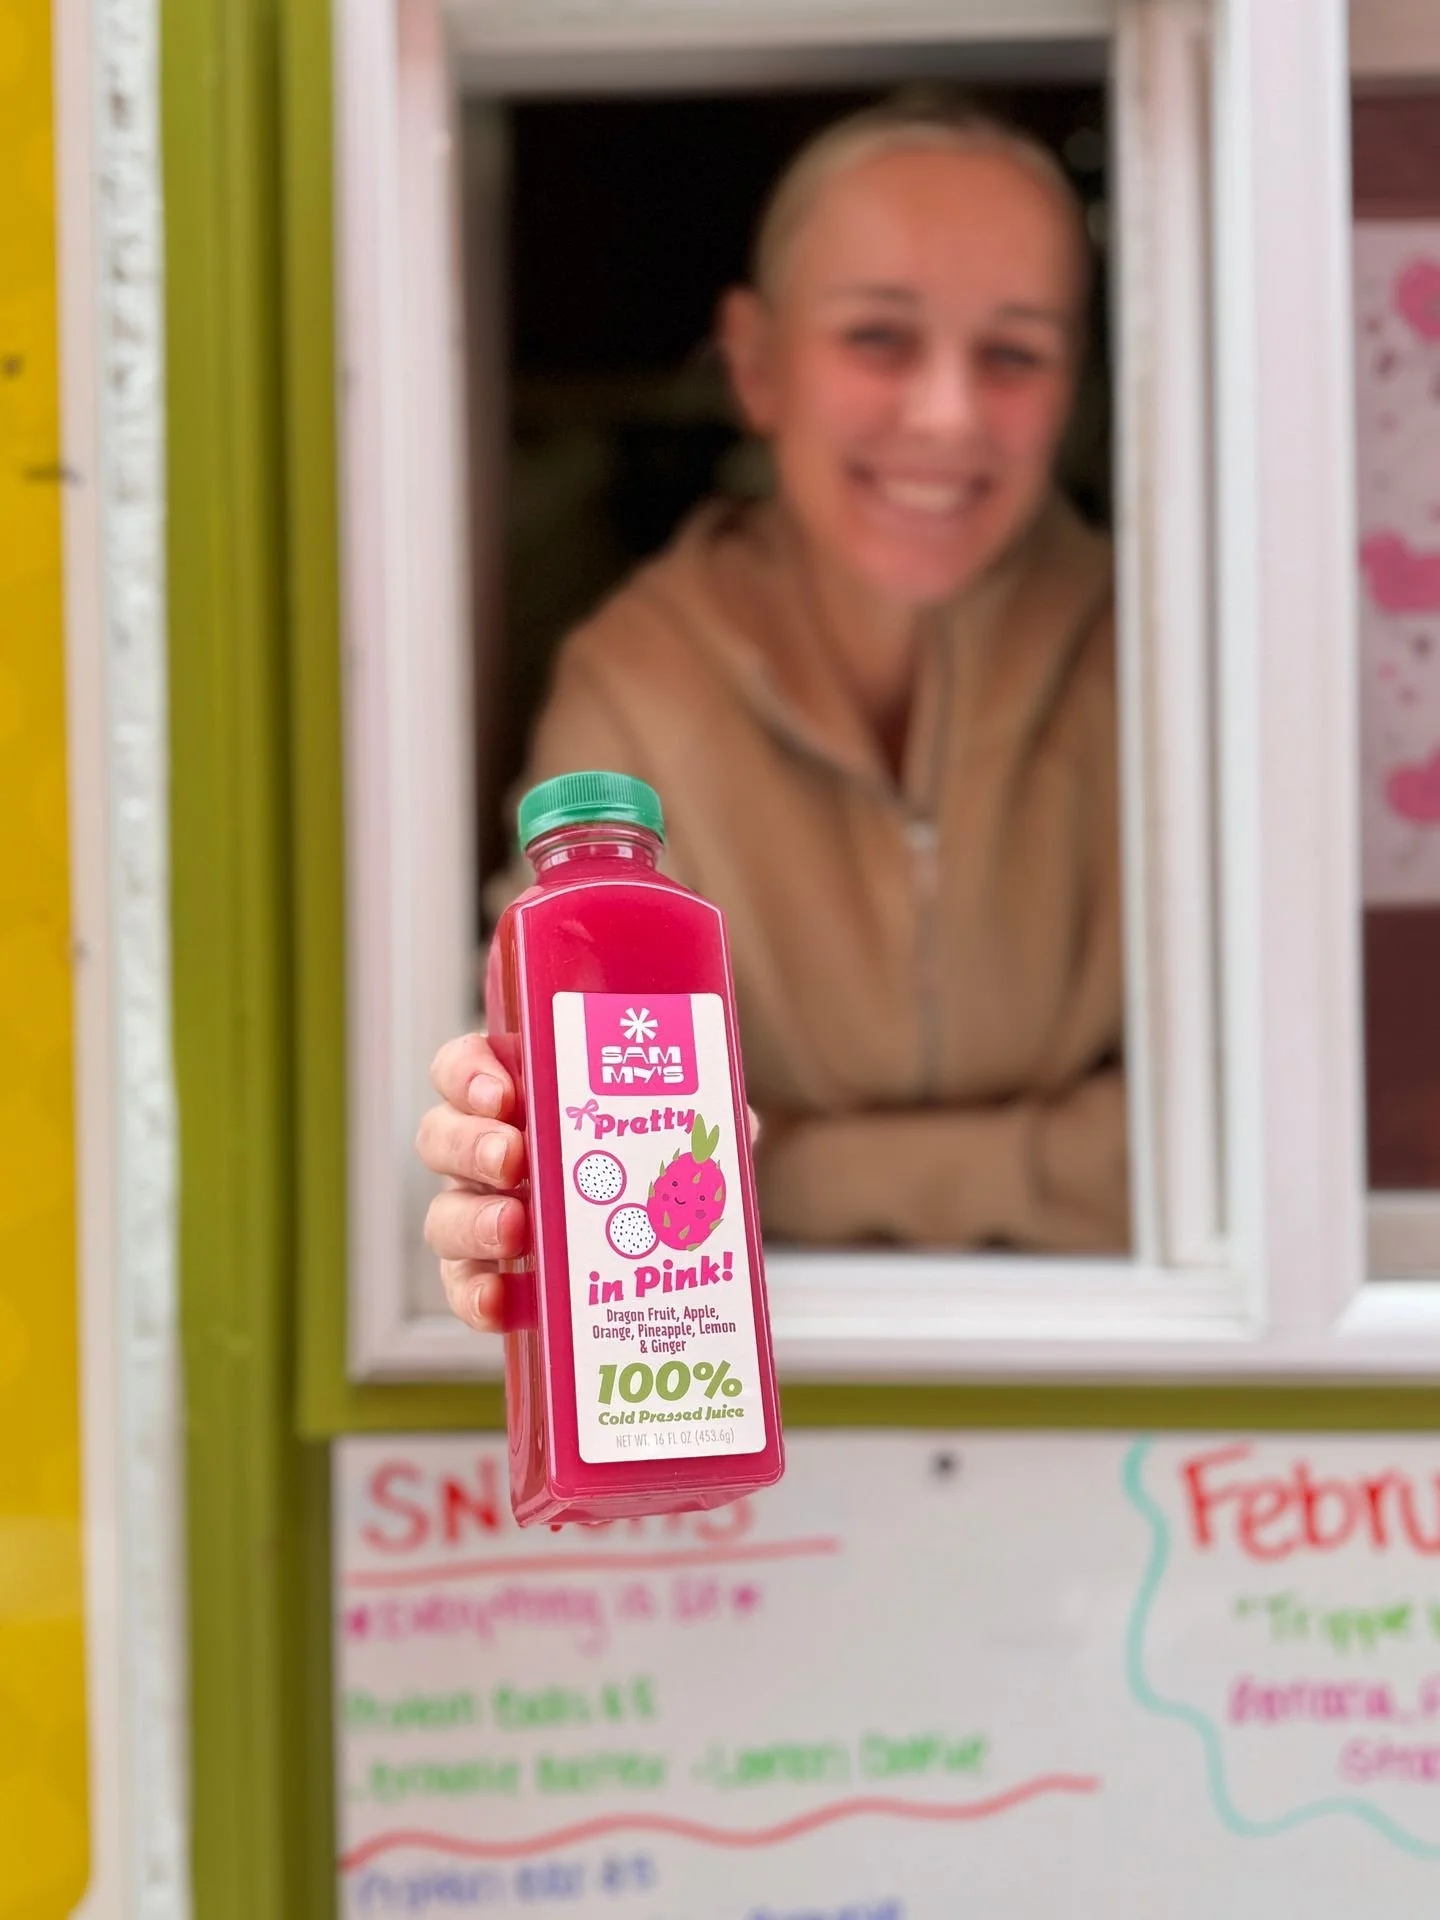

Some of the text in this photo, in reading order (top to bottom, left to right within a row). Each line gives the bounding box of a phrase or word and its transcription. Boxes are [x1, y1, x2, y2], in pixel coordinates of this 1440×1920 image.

[601, 1046, 682, 1064] SAM
[602, 1066, 685, 1084] MY'S
[594, 1107, 695, 1140] Pretty
[588, 1251, 734, 1305] in Pink!
[607, 1305, 719, 1324] Dragon Fruit, Apple,
[592, 1319, 736, 1341] Orange, Pineapple, Lemon
[640, 1339, 687, 1355] & Ginger
[597, 1360, 743, 1405] 100%
[598, 1404, 744, 1426] Cold Pressed Juice
[616, 1427, 735, 1448] NET WT. 16 FL OZ (453.6g)
